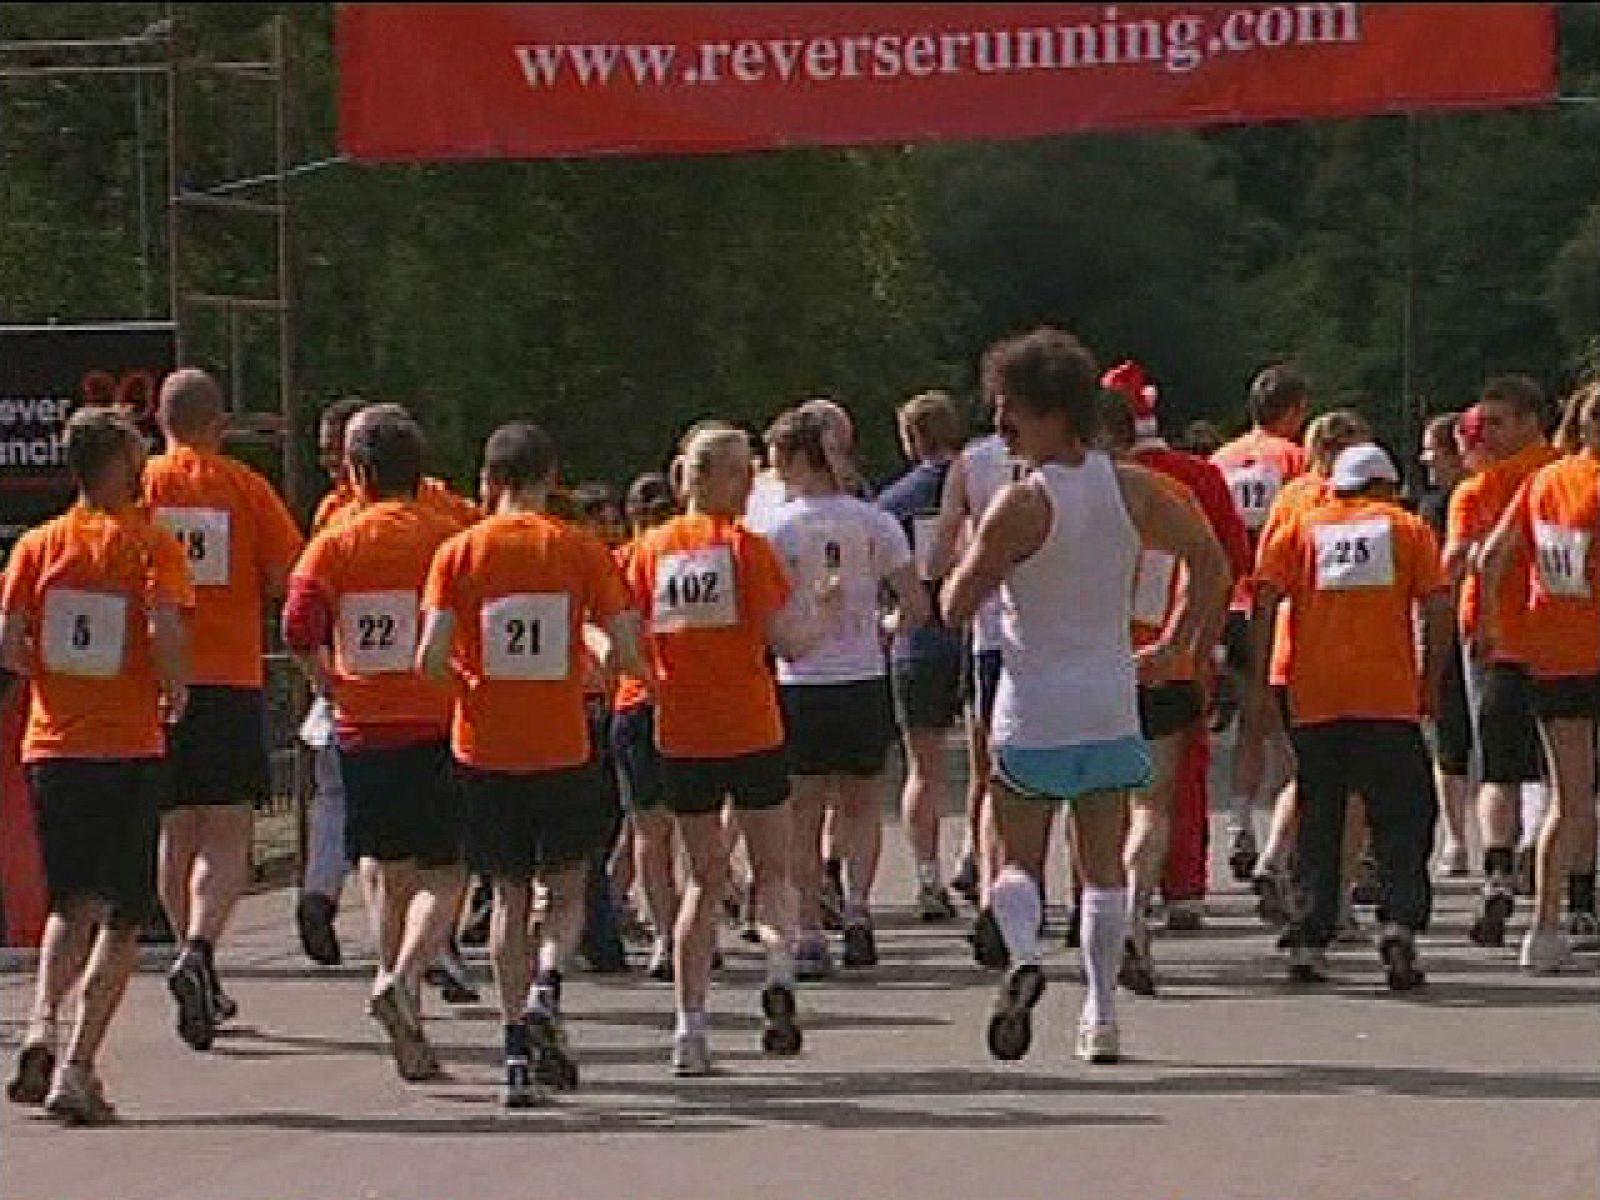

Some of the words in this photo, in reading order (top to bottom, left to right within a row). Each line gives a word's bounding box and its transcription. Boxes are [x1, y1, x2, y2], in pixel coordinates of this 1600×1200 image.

[515, 3, 1360, 87] www.reverserunning.com
[1335, 536, 1371, 564] 25
[666, 571, 720, 607] 102
[359, 614, 395, 650] 22
[506, 619, 541, 655] 21
